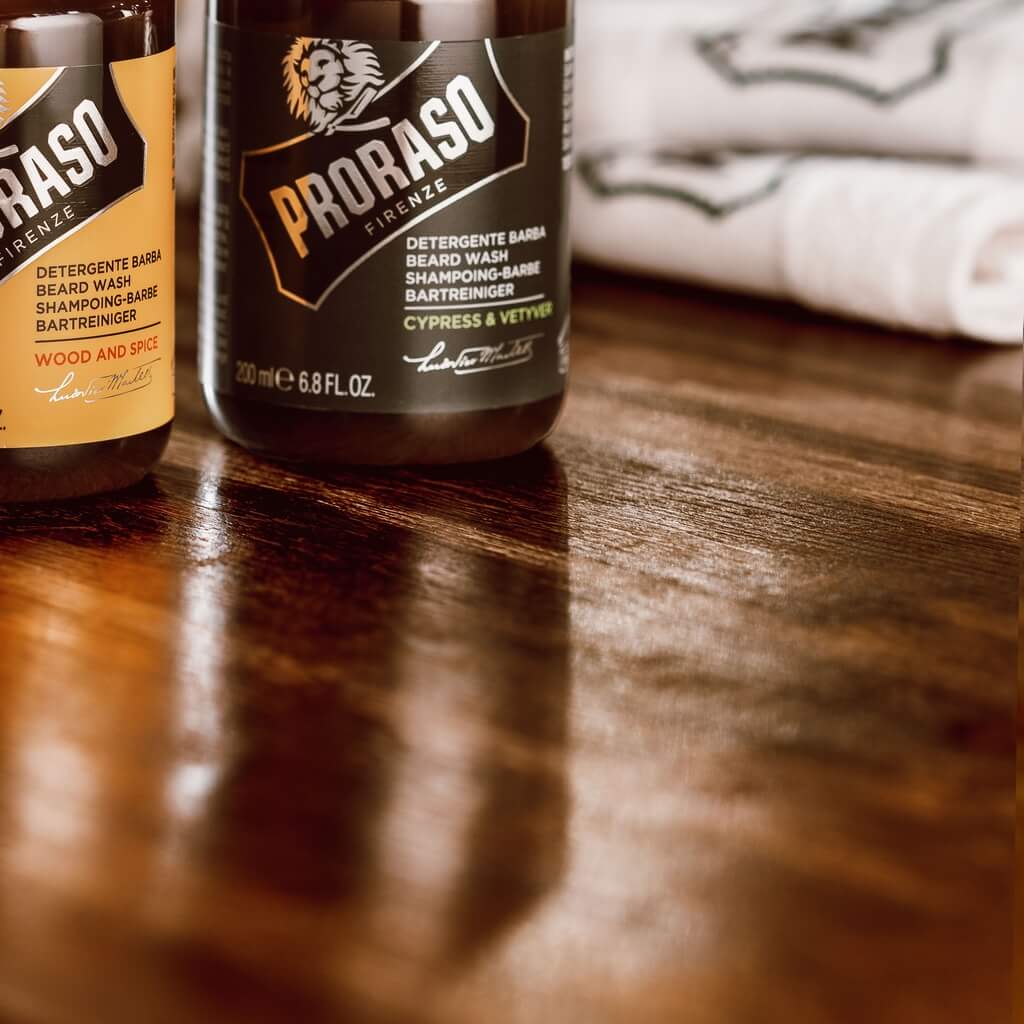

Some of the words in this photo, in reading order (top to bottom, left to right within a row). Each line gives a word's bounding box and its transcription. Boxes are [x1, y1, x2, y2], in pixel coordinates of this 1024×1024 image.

[269, 74, 494, 259] PRORASO
[364, 177, 447, 237] FIRENZE
[406, 232, 506, 250] DETERGENTE
[509, 226, 547, 244] BARBA
[36, 258, 129, 279] DETERGENTE
[131, 249, 162, 268] BARBA
[406, 253, 461, 268] BEARD
[465, 249, 509, 266] WASH
[405, 261, 541, 285] SHAMPOING-BARBE
[36, 282, 89, 297] BEARD
[93, 275, 131, 292] WASH
[405, 283, 515, 302] BARTREINIGER
[36, 285, 158, 314] SHAMPOING-BARBE
[36, 309, 137, 332] BARTREINIGER
[403, 313, 482, 330] CYPRESS
[485, 312, 497, 326] &
[35, 350, 92, 367] WOOD
[96, 344, 127, 362] AND
[130, 336, 158, 356] SPICE
[299, 370, 322, 394] 6.8
